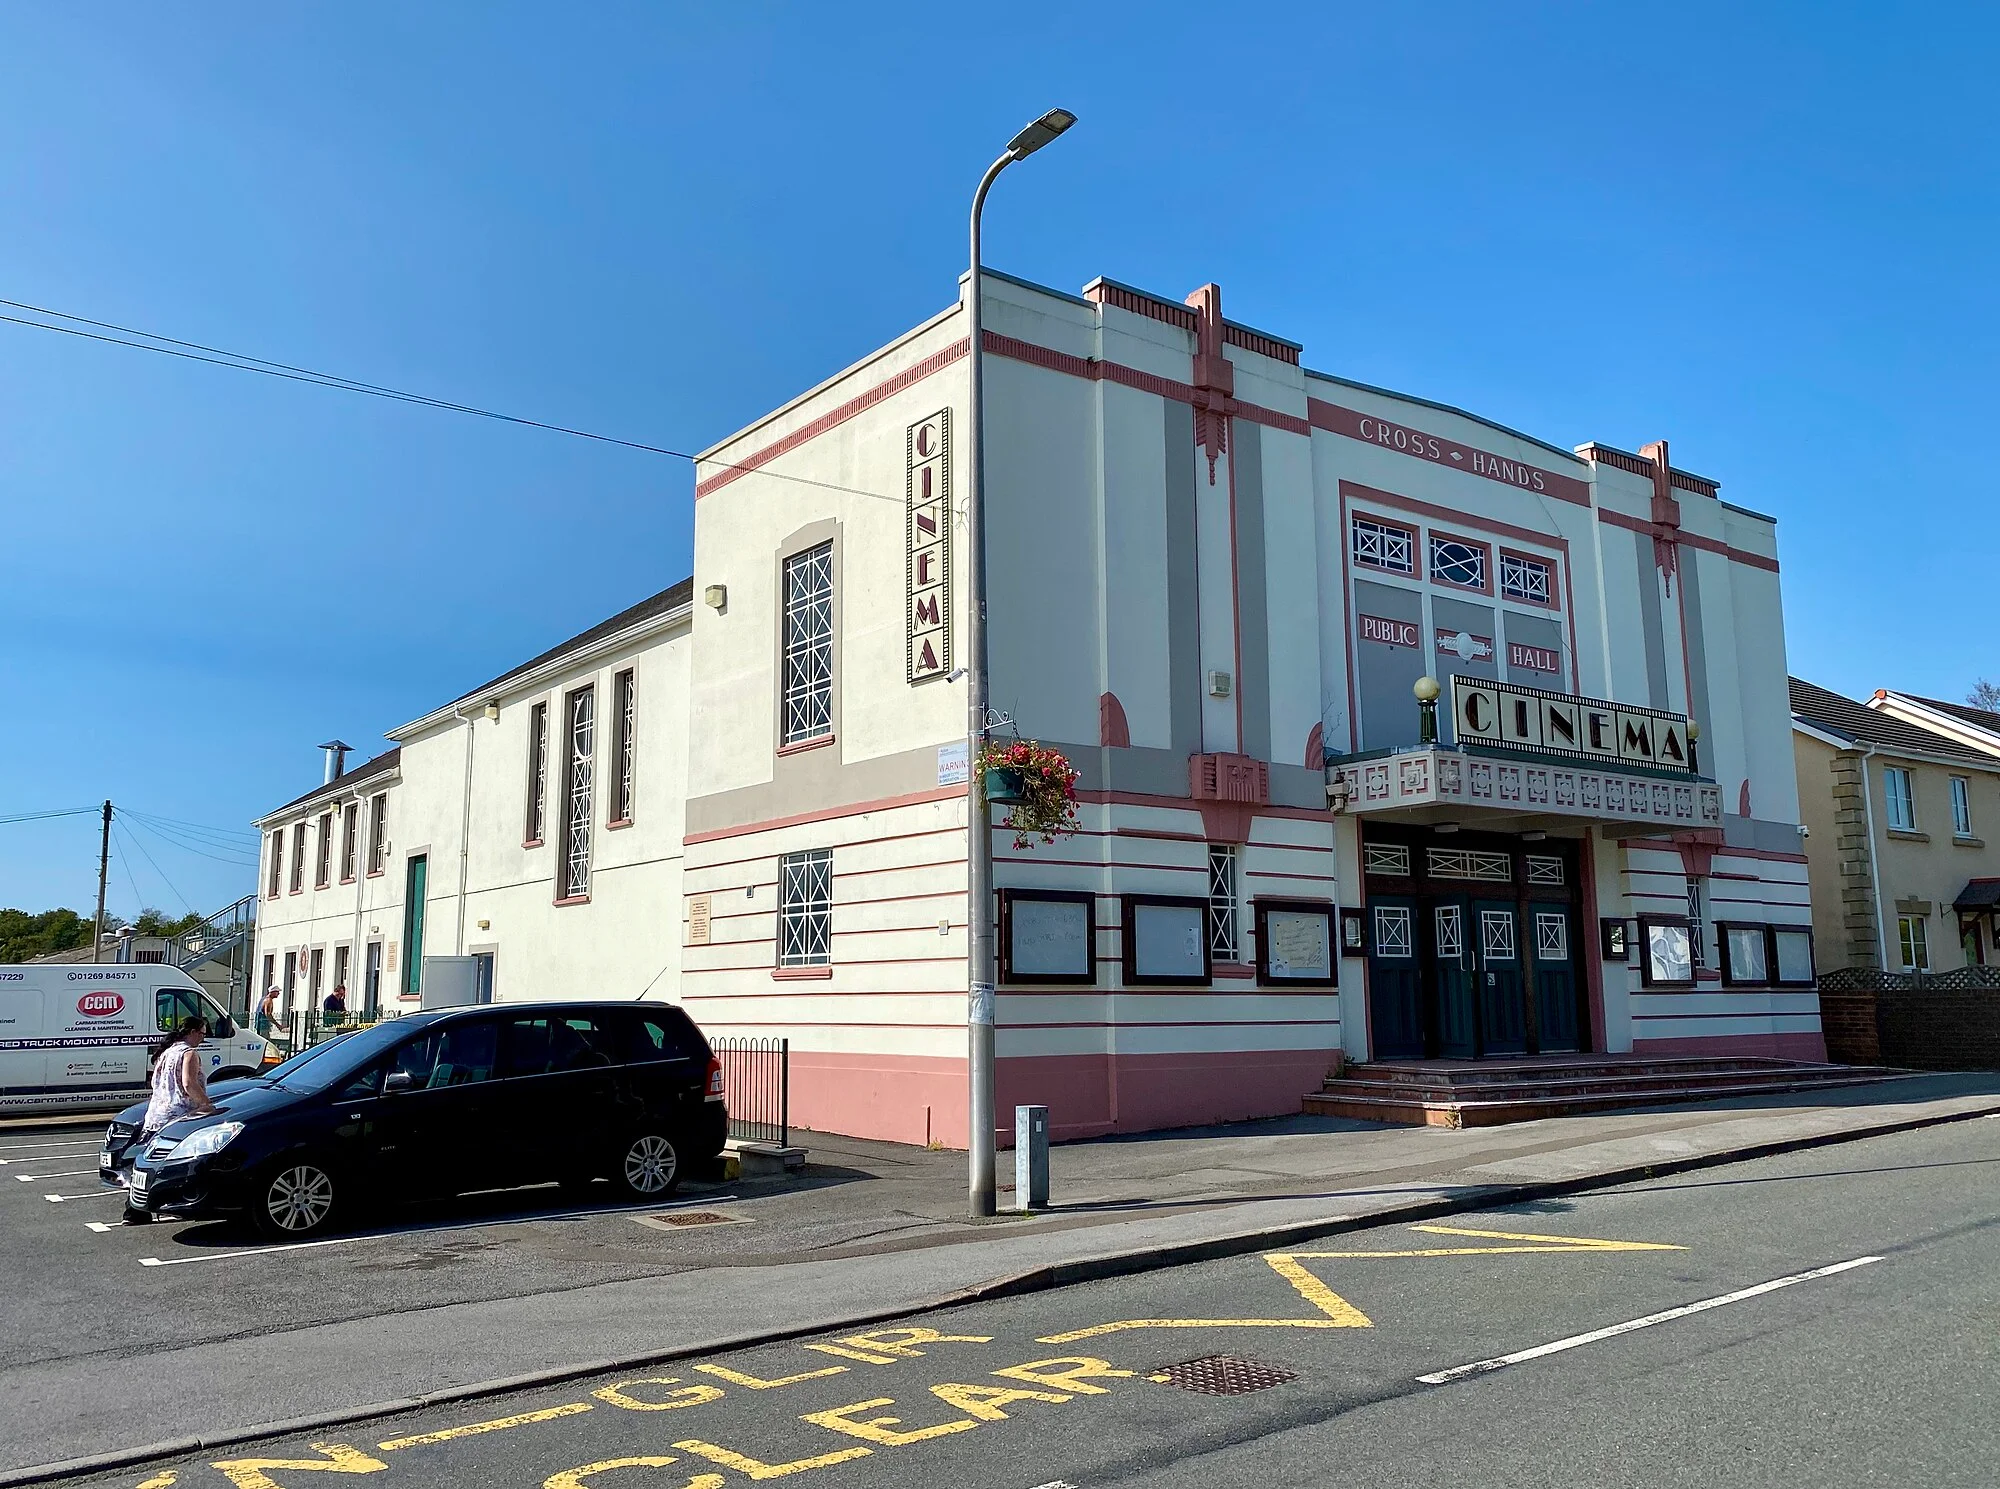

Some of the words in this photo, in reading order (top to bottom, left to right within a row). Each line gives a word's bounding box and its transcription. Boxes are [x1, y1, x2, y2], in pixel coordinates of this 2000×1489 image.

[1359, 418, 1441, 460] CROSS
[1472, 452, 1546, 491] HANDS
[914, 424, 940, 675] CINEMA
[1363, 617, 1417, 646] PUBLIC
[1512, 646, 1557, 672] HALL
[1465, 692, 1685, 761] CINEMA
[77, 972, 103, 980] 01269
[105, 972, 136, 980] 845713
[22, 1039, 61, 1047] TRUCK
[63, 1038, 119, 1046] MOUNTED
